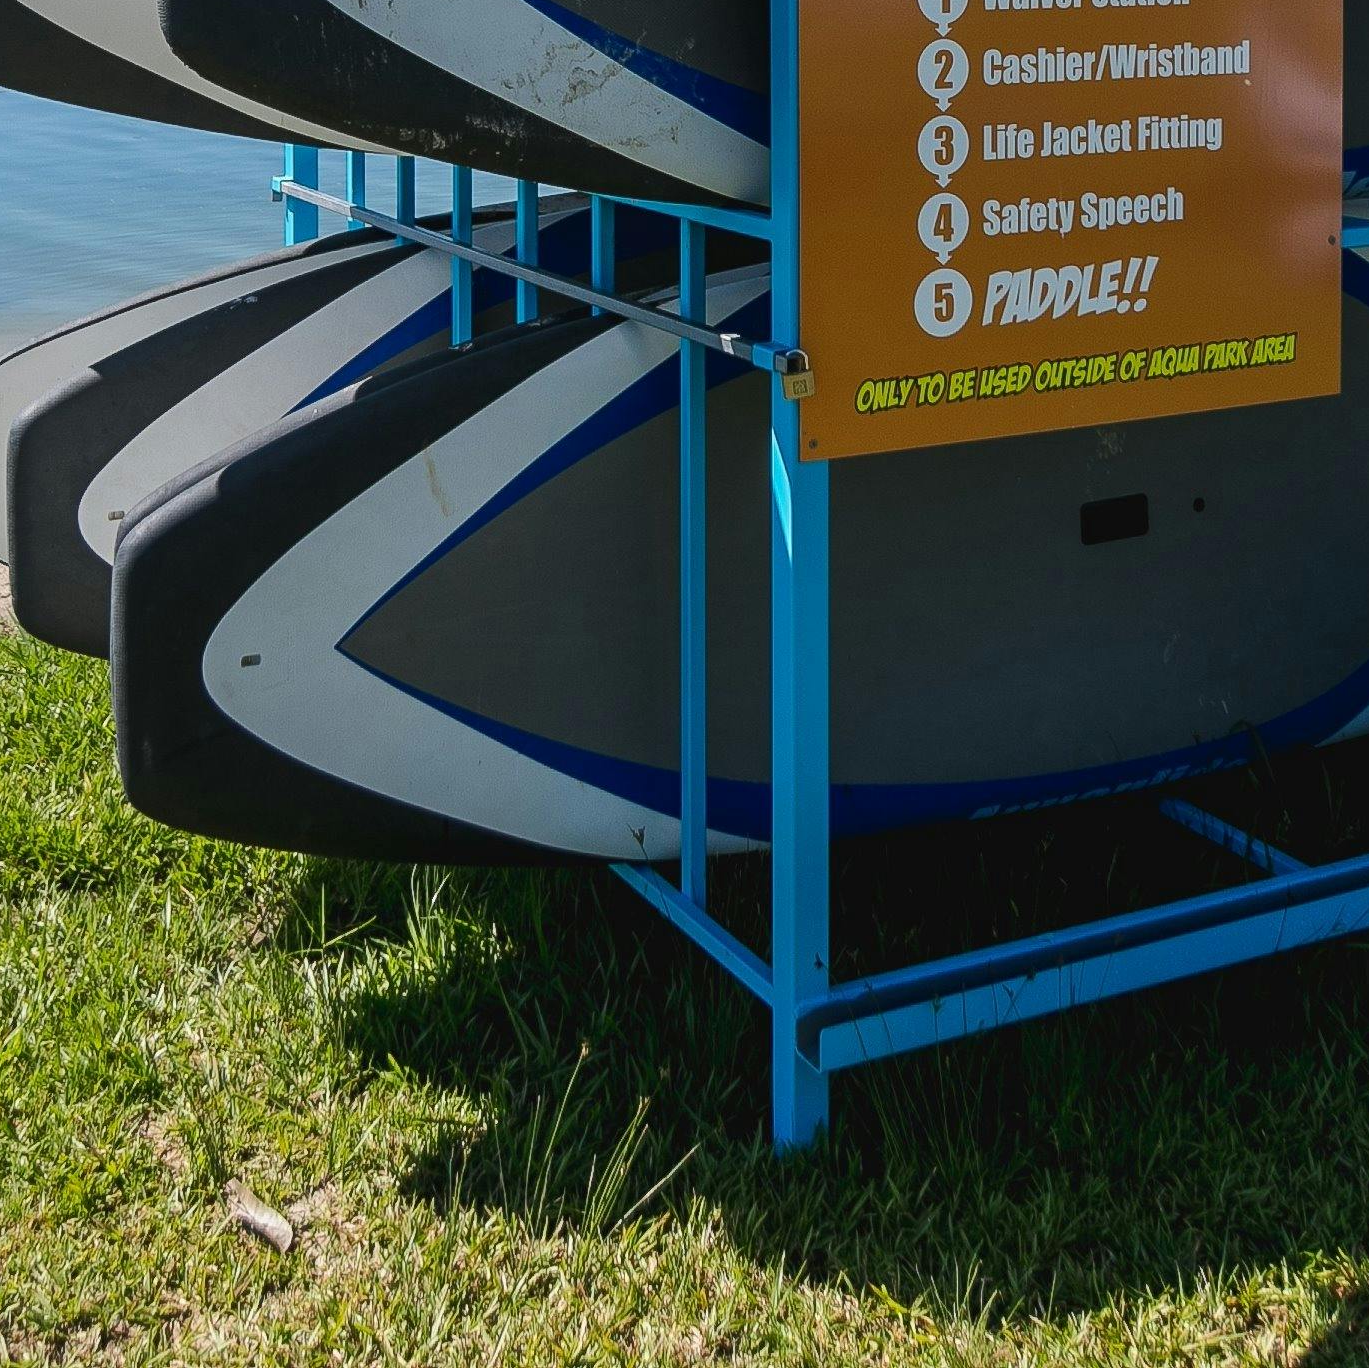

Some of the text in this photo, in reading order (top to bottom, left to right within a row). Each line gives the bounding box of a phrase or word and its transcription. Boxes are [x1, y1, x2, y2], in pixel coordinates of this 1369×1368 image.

[933, 41, 1251, 90] 2 Cashier/Wristband
[932, 116, 1223, 166] 3 Life Jacket Fitting
[933, 188, 1184, 242] 4 Safety Speech
[933, 256, 1159, 327] 5 PADDLE!!
[855, 333, 1298, 414] ONLY TO BE USED OUTSIDE OF AQUA PARK AREA
